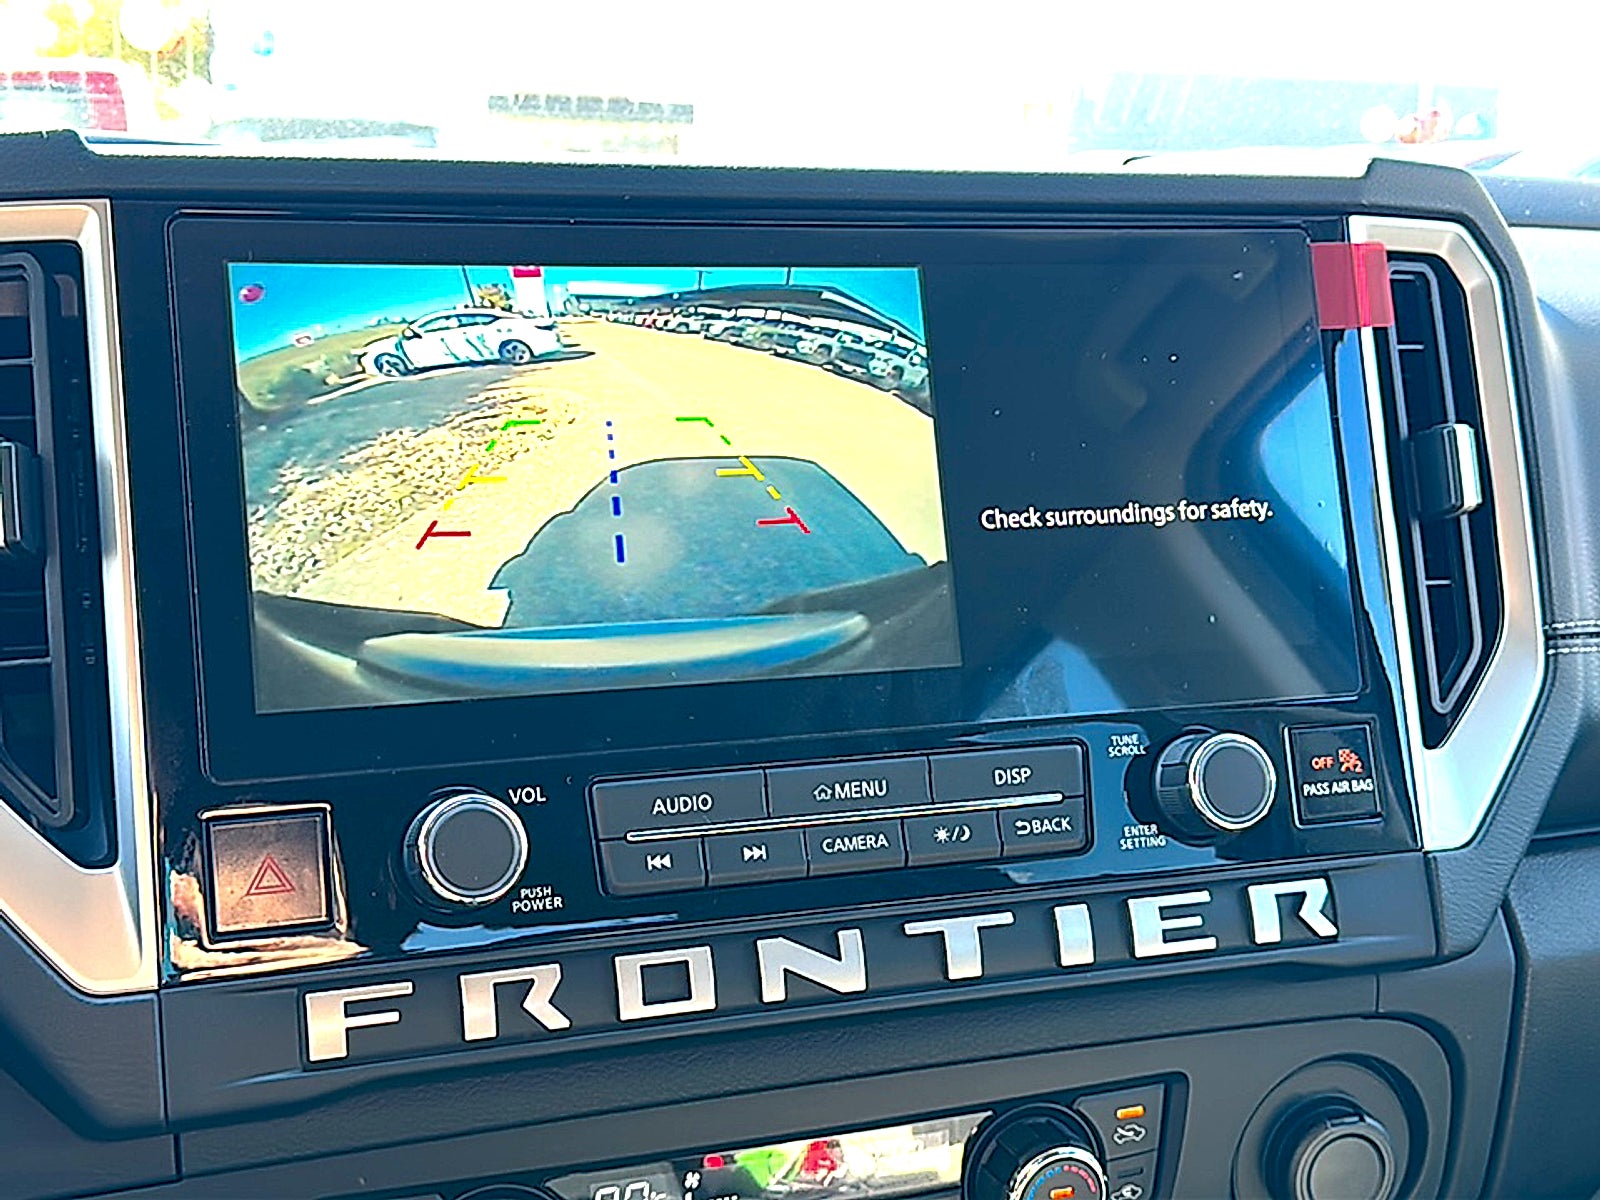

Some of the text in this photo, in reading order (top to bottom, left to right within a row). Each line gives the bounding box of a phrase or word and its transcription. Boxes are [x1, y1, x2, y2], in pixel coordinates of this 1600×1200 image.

[980, 497, 1274, 530] Check surroundings for safety.
[1110, 733, 1140, 746] TUNE
[1108, 745, 1147, 757] SCROLL
[1311, 756, 1335, 770] OFF
[993, 767, 1032, 786] DISP
[508, 786, 548, 804] VOL
[834, 779, 889, 799] MENU
[1303, 778, 1374, 797] PASS AIR BAG
[651, 793, 713, 815] AUDIO
[1031, 814, 1072, 834] BACK
[1123, 823, 1158, 837] ENTER
[821, 833, 890, 855] CAMERA
[1119, 834, 1167, 850] SETTING
[520, 885, 552, 899] PUSH
[512, 896, 563, 913] POWER
[305, 877, 1338, 1062] FRONTIER
